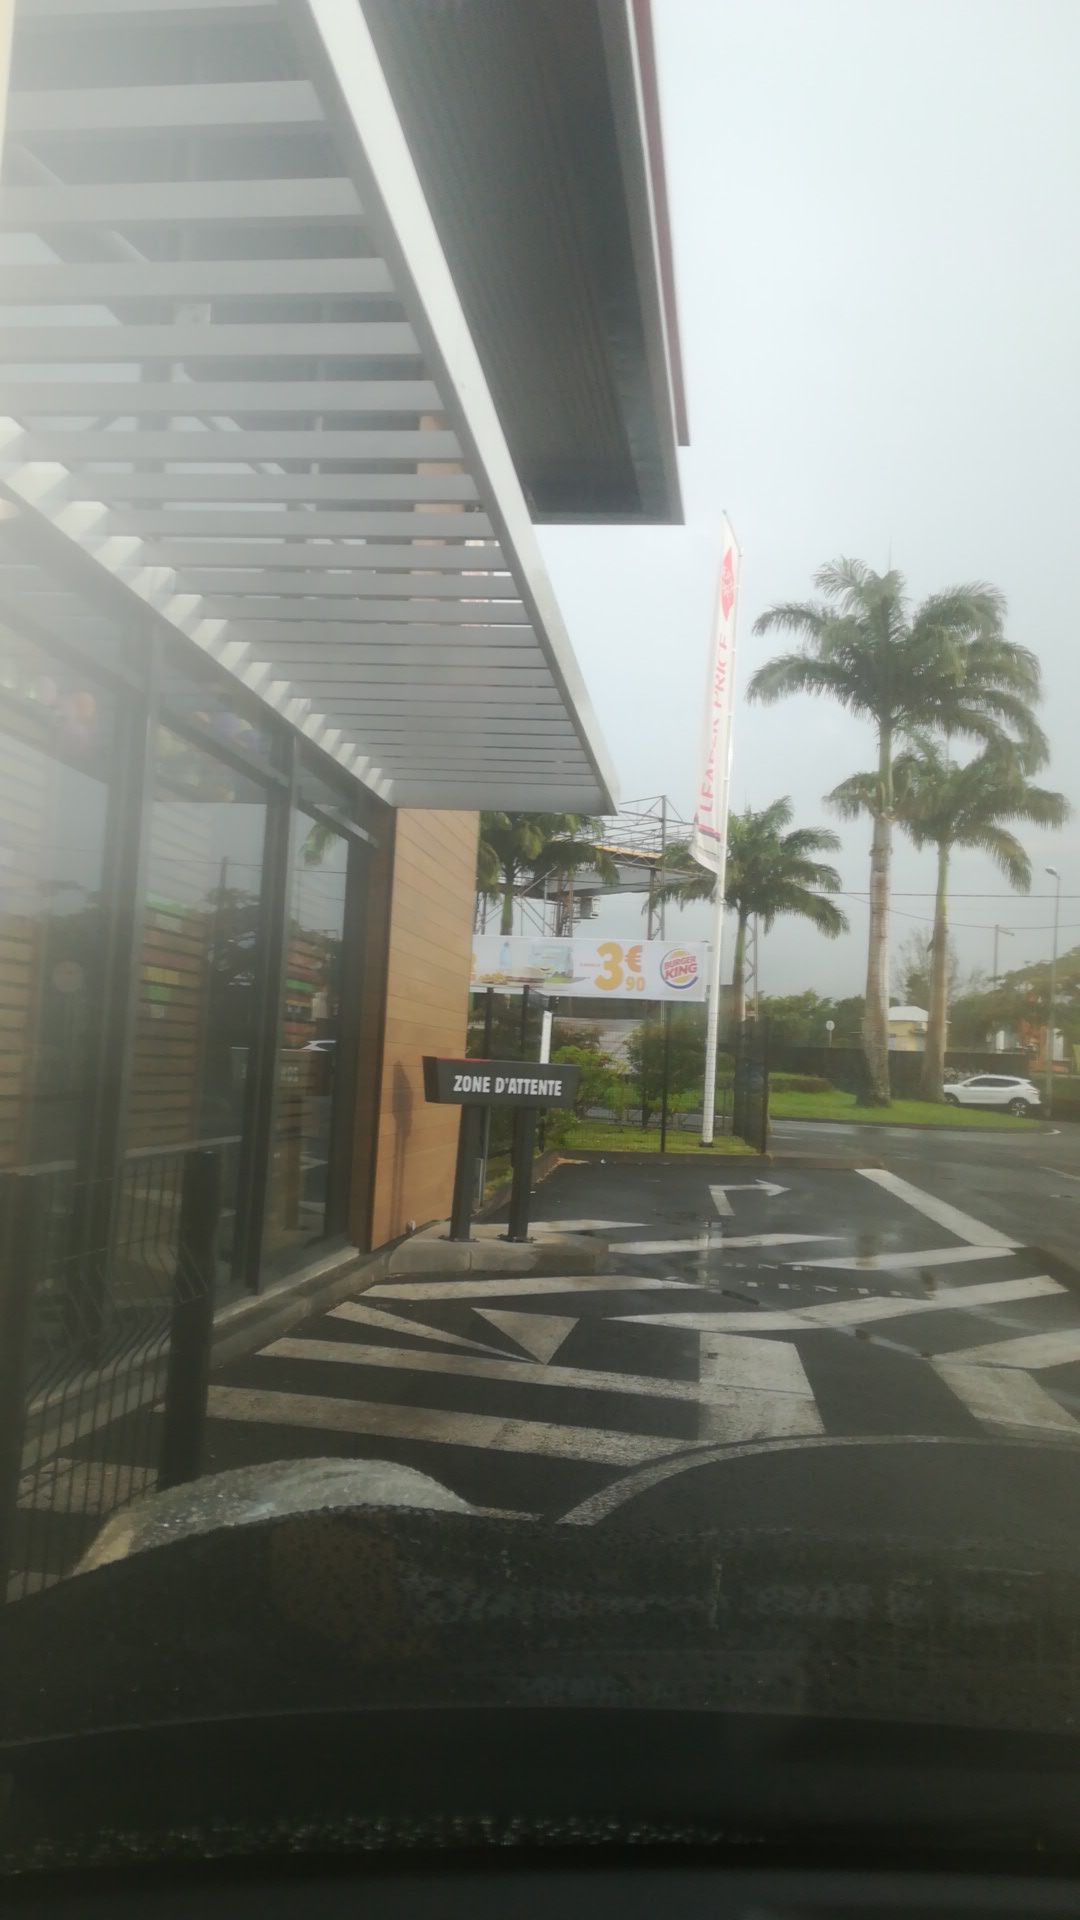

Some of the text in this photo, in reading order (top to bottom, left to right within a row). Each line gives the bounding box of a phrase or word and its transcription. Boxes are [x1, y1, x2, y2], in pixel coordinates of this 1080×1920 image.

[699, 717, 720, 813] LEA
[664, 955, 697, 971] BURGER
[664, 963, 698, 980] KING
[453, 1075, 563, 1096] ZONE D'ATTENTE
